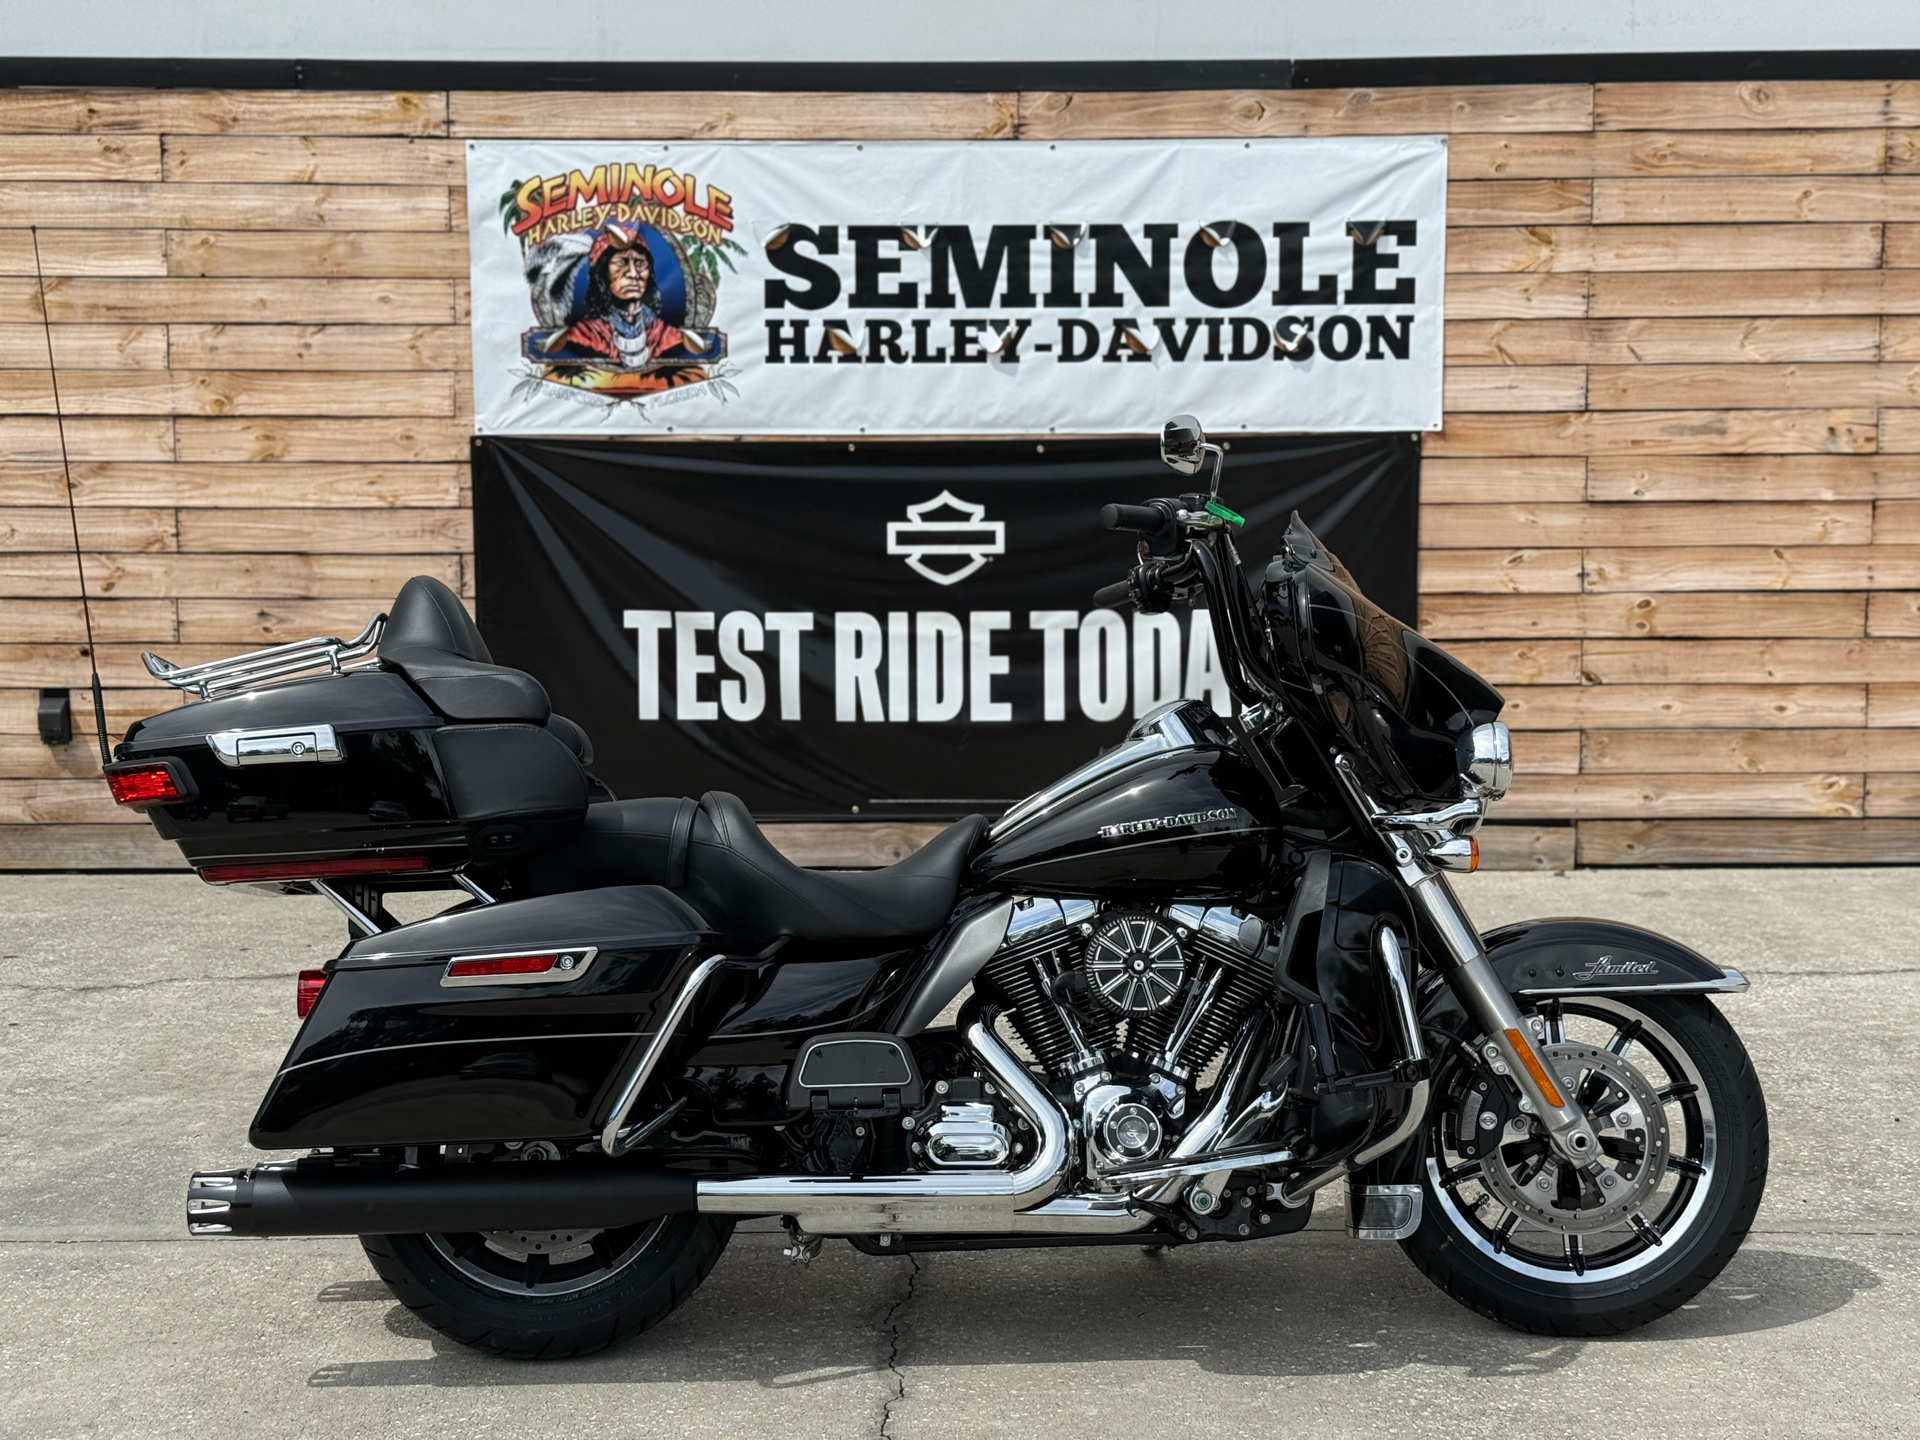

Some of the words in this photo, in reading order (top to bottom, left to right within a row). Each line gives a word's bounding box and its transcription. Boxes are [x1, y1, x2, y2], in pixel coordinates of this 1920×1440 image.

[511, 163, 734, 236] SEMINOLE
[528, 203, 724, 246] HARLEY-DAVIDSON
[764, 220, 1417, 310] SEMINOLE
[765, 315, 1414, 364] HARLEY-DAVIDSON
[541, 382, 606, 410] SANFORD
[650, 383, 708, 410] FLORIDA
[623, 609, 815, 722] TEST
[835, 610, 1012, 722] RIDE
[1029, 609, 1249, 721] TODA
[1572, 954, 1660, 981] Limited
